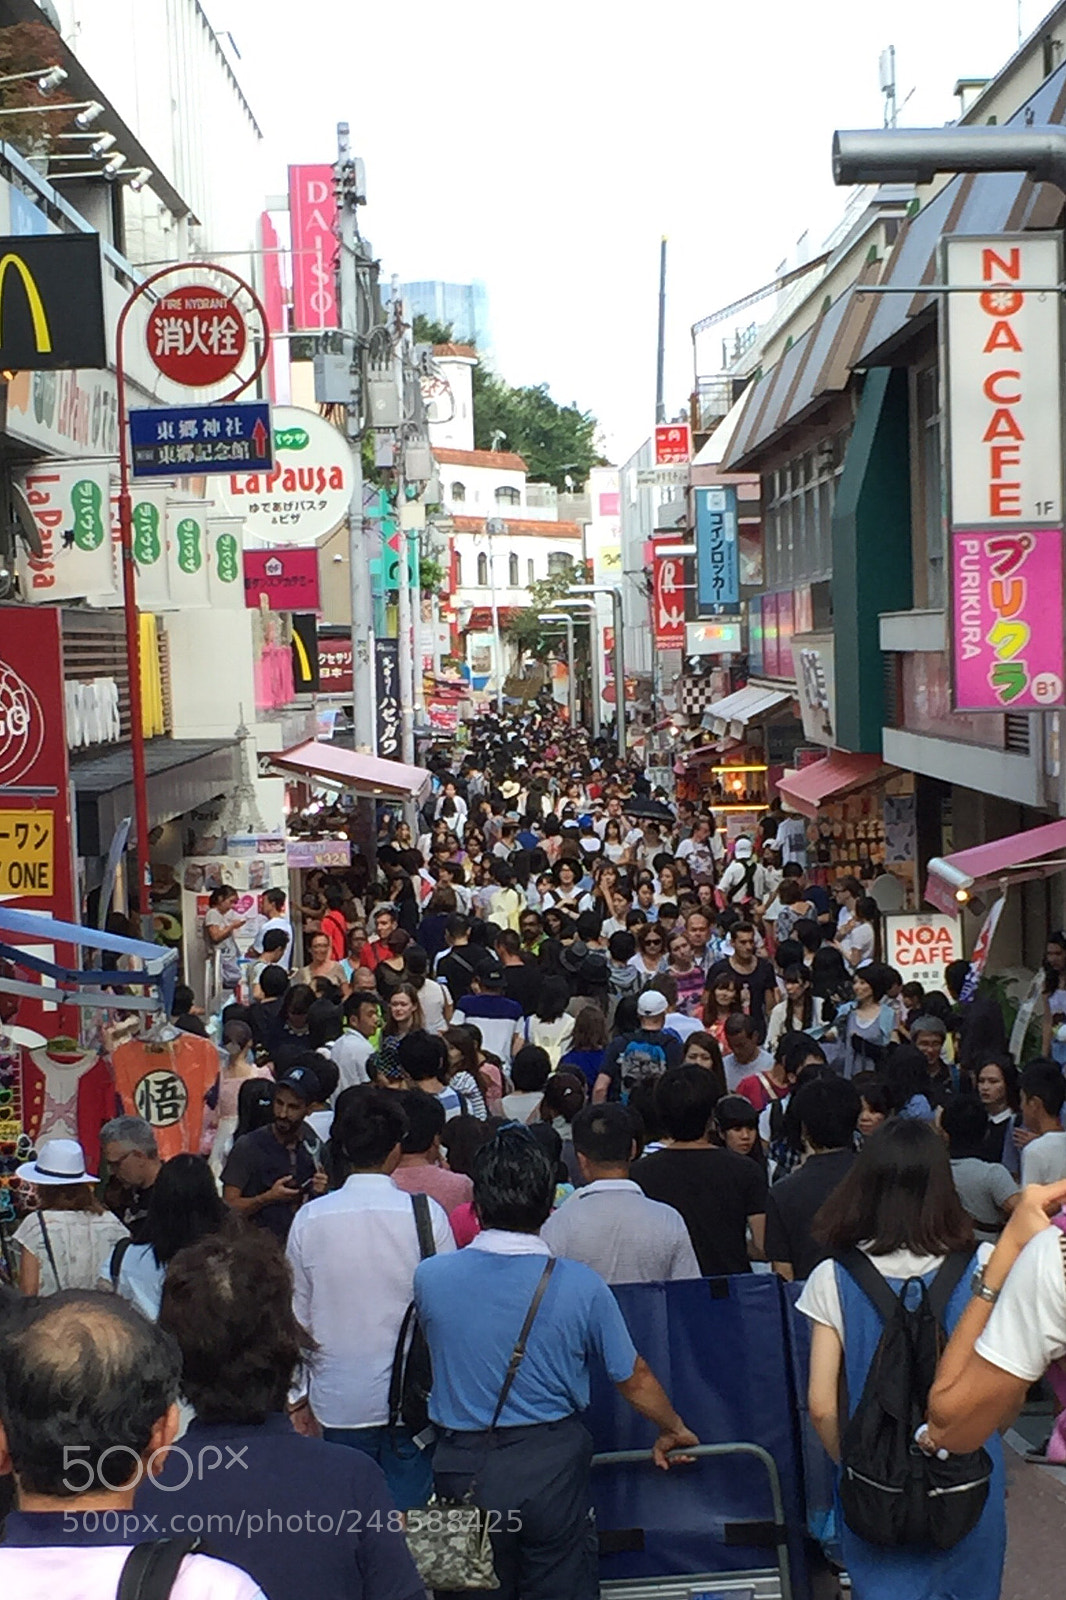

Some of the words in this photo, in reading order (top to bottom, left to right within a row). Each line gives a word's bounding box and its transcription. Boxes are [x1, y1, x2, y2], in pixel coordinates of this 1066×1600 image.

[305, 181, 332, 314] DAISO
[161, 298, 182, 310] FIRE
[184, 298, 228, 310] HYDRANT
[979, 248, 1024, 354] NOA
[155, 315, 239, 356] 消火栓
[157, 417, 244, 440] 東郷神社
[982, 370, 1025, 517] CAFE
[158, 441, 249, 464] 東郷記念館
[25, 475, 60, 505] La
[266, 460, 343, 495] Pausa
[1035, 501, 1054, 516] 1F
[710, 513, 725, 601] コインロッカー
[960, 539, 981, 660] PURIKURA
[985, 533, 1035, 705] プリクラ
[1037, 681, 1056, 696] B1
[8, 862, 49, 889] ONE
[895, 926, 953, 946] NOA
[895, 946, 953, 966] CAFE
[138, 1076, 187, 1122] 悟
